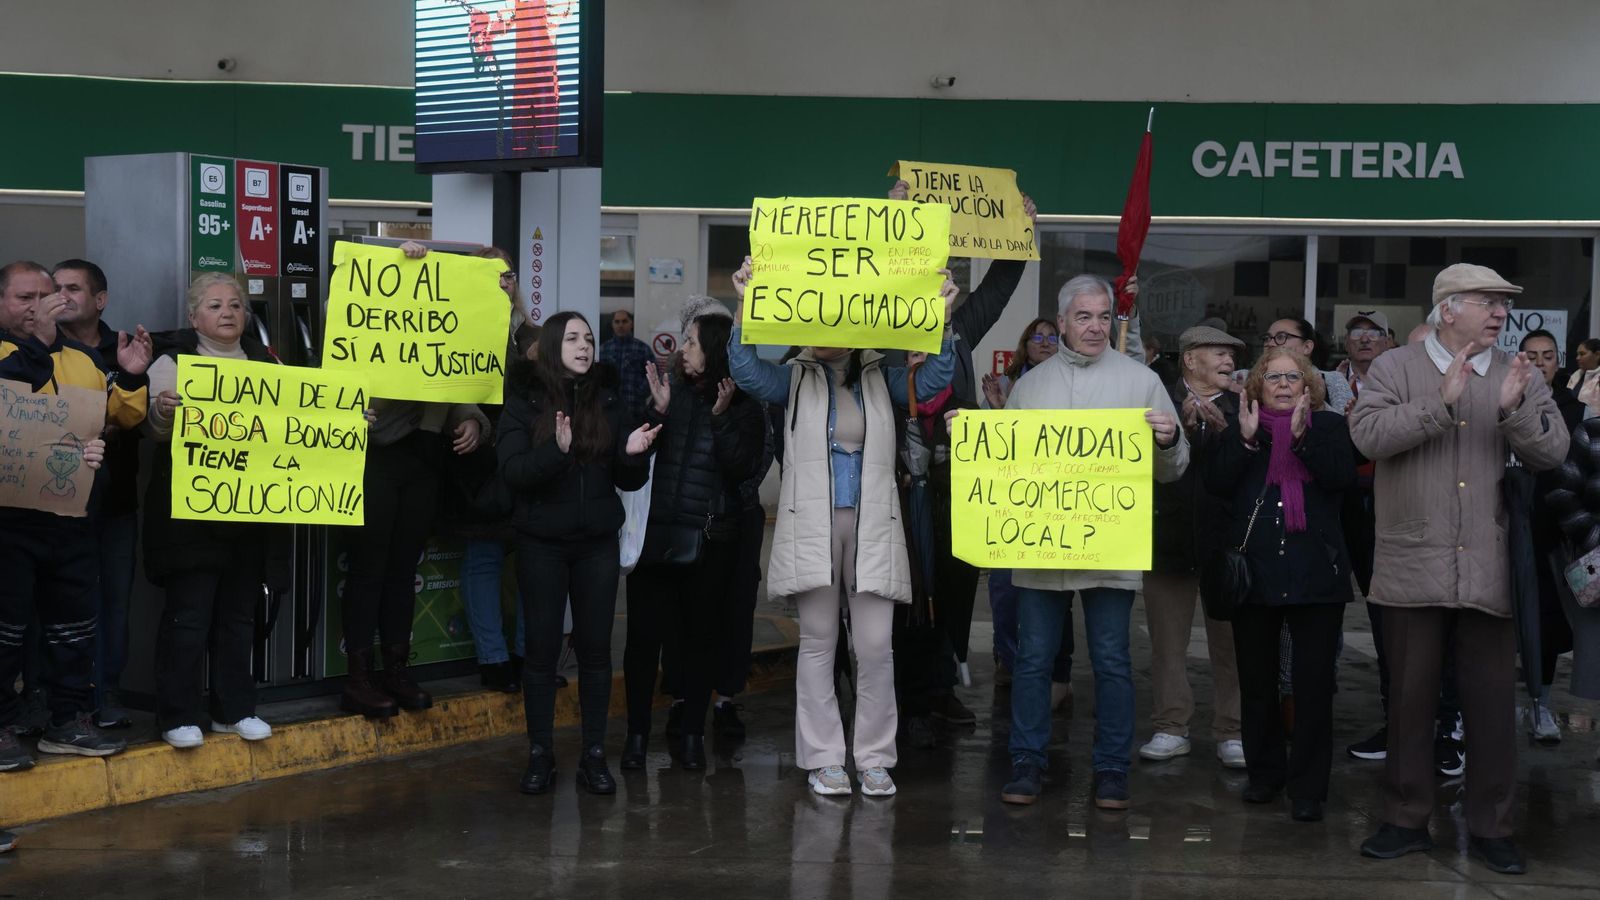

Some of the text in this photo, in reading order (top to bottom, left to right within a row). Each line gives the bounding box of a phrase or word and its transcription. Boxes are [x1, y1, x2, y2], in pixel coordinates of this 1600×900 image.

[1192, 140, 1464, 178] CAFETERIA
[208, 175, 218, 183] E5
[911, 169, 984, 193] TIENE LA
[200, 199, 226, 208] Gasolina
[242, 203, 272, 212] Superdiesel
[291, 207, 309, 216] Diesel
[198, 214, 230, 235] 95+
[250, 216, 273, 240] A+
[293, 220, 315, 244] A+
[753, 204, 924, 242] MERECEMOS
[752, 243, 773, 262] 20
[888, 246, 931, 257] EN PARO
[973, 237, 987, 249] NO
[990, 239, 1002, 250] LA
[1007, 228, 1033, 257] DAN?
[807, 247, 880, 277] SER
[888, 267, 929, 277] NAVIDAD
[919, 258, 930, 266] DE
[349, 258, 450, 302] NO AL
[750, 286, 939, 332] ESCUCHADOS
[1505, 312, 1544, 333] NO
[331, 336, 358, 362] SÍ
[370, 342, 385, 363] A
[399, 342, 419, 363] LA
[1504, 335, 1518, 347] LA
[184, 363, 365, 414] JUAN DE LA
[181, 406, 367, 452] ROSA BONSÓN
[955, 416, 1142, 462] ¿ASÍ AYUDAIS
[273, 454, 300, 470] LA
[1031, 463, 1047, 475] DE
[968, 477, 1136, 512] AL COMERCIO
[1025, 511, 1034, 519] DE
[1071, 513, 1121, 525] AFECTADOS
[1016, 551, 1026, 560] DE
